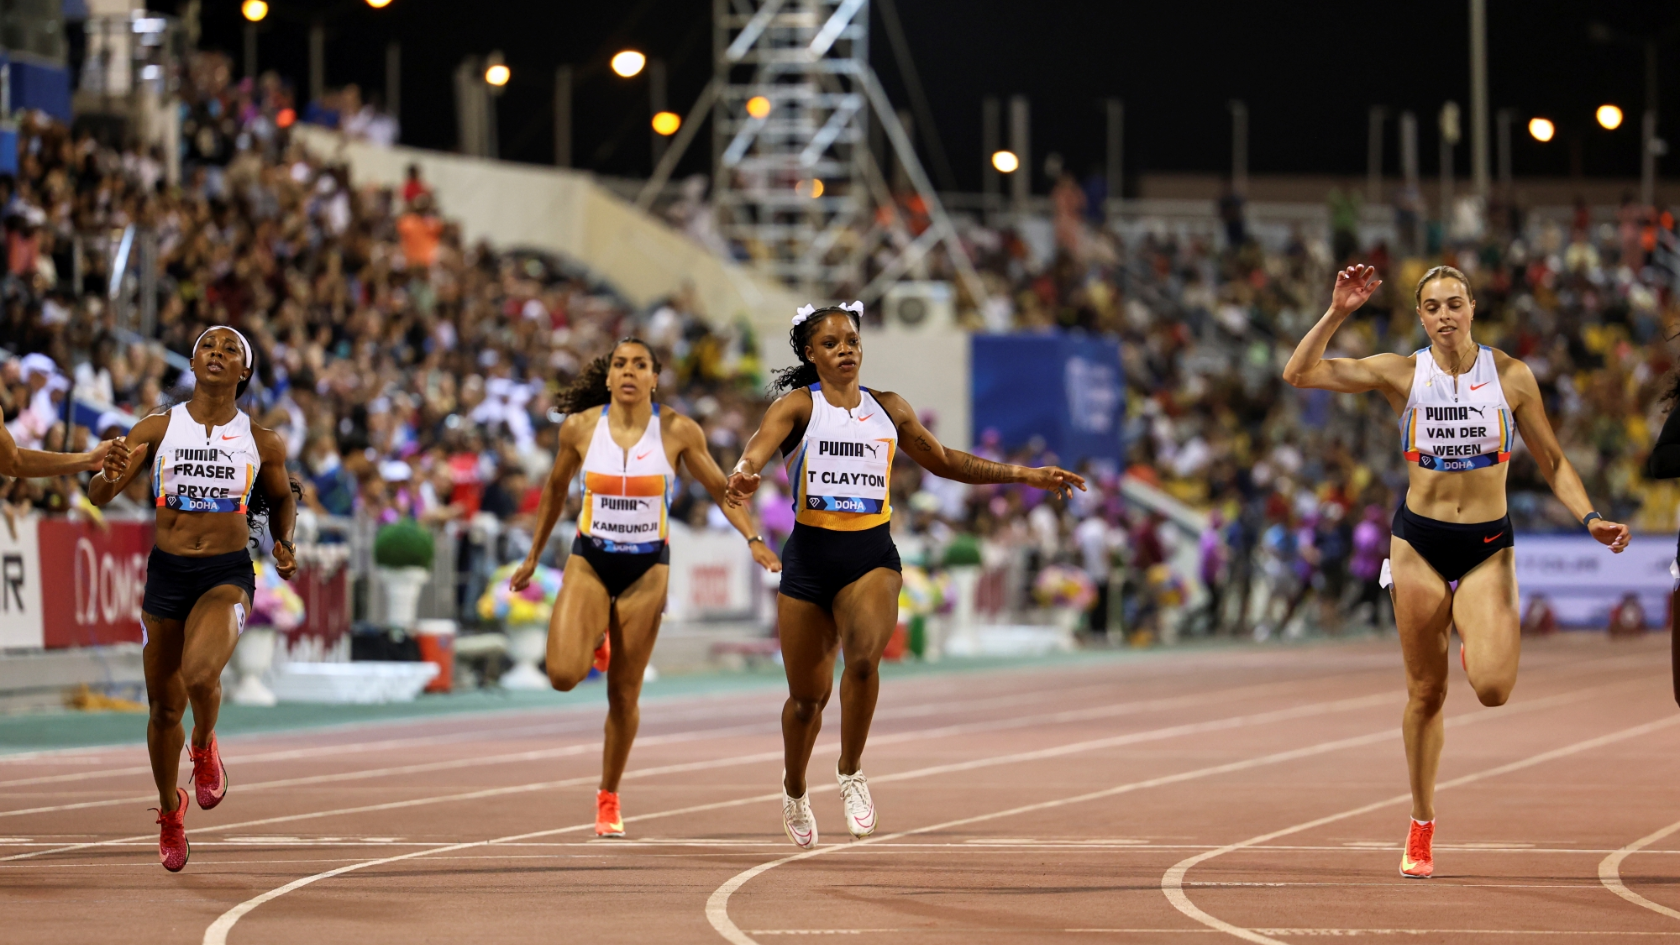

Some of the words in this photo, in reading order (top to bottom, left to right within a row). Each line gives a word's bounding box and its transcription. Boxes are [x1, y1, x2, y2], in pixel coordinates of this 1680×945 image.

[1425, 406, 1468, 421] PUMA
[1426, 427, 1455, 439] VAN
[1460, 426, 1487, 438] DER
[175, 448, 218, 462] PUMA
[819, 440, 864, 457] PUMA
[1433, 444, 1482, 456] WEKEN
[173, 463, 236, 480] FRASER
[1444, 460, 1474, 470] DOHA
[808, 470, 817, 483] T
[821, 471, 885, 488] CLAYTON
[177, 484, 230, 499] PRYCE
[189, 500, 218, 510] DOHA
[601, 497, 638, 511] PUMA
[835, 500, 865, 510] DOHA
[592, 520, 658, 534] KAMBUNDJI
